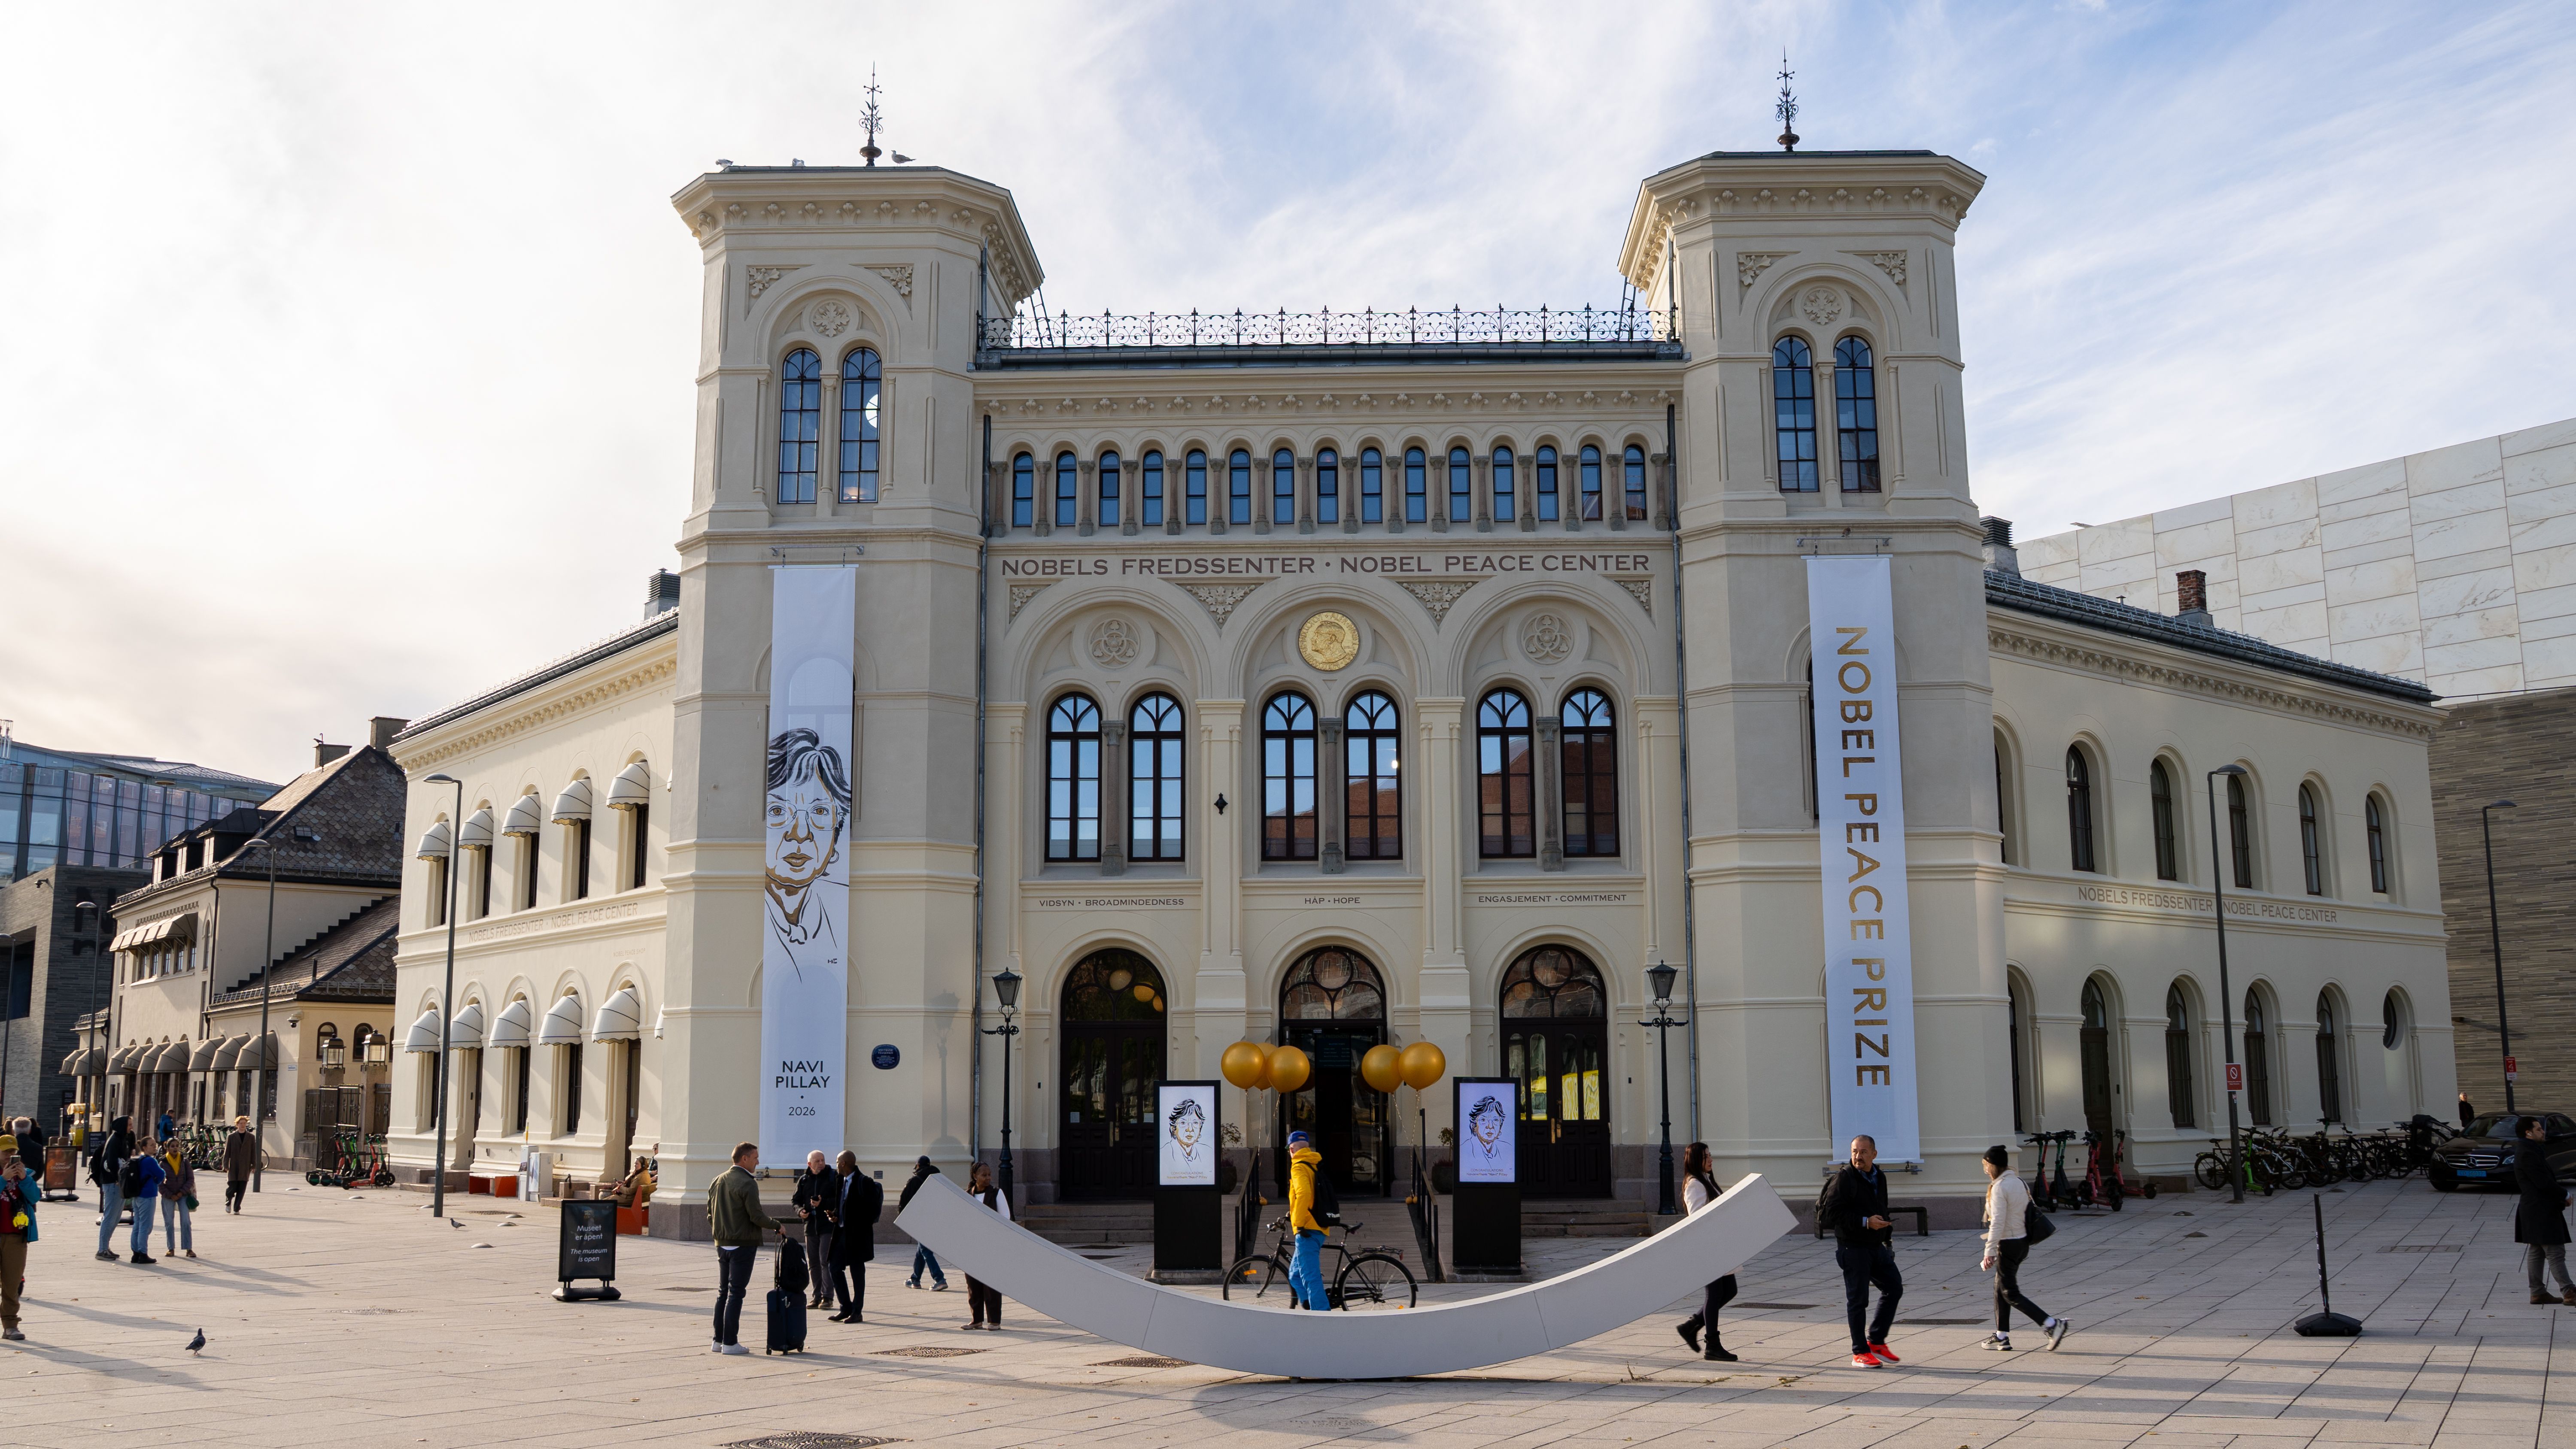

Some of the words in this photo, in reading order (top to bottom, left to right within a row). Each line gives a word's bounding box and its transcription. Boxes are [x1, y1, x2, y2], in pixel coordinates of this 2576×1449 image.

[1002, 559, 1108, 575] NOBELS
[1122, 557, 1315, 575] FREDSSENTER
[1340, 556, 1432, 573] NOBEL
[1445, 555, 1534, 571] PEACE
[1541, 555, 1649, 571] CENTER
[1835, 626, 1876, 778] NOBEL
[1844, 792, 1884, 941] PEACE
[469, 928, 494, 942] NOBELS
[496, 919, 544, 937] FREDSSENTER
[551, 913, 576, 927] NOBEL
[578, 908, 603, 922] PEACE
[606, 902, 638, 919] CENTER
[2079, 886, 2127, 905] NOBELS
[2132, 891, 2213, 912] FREDSSENTER
[2223, 901, 2260, 916] NOBEL
[2262, 903, 2295, 920] PEACE
[2299, 908, 2337, 923] CENTER
[1852, 958, 1891, 1088] PRIZE
[776, 1076, 830, 1088] PILLAY
[782, 1061, 824, 1073] NAVI
[788, 1106, 815, 1116] 2026
